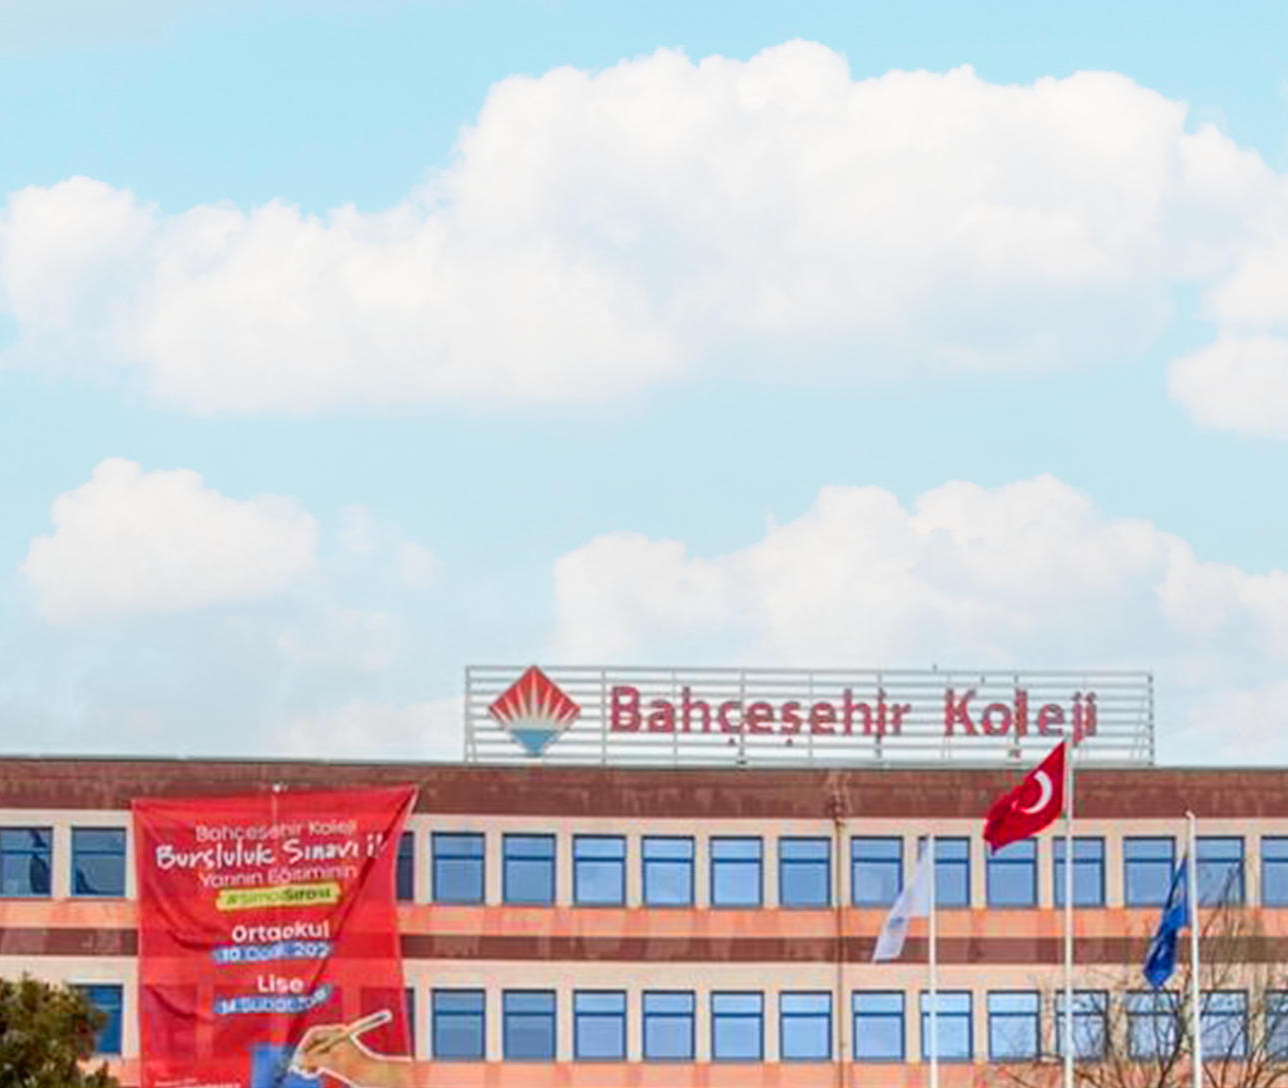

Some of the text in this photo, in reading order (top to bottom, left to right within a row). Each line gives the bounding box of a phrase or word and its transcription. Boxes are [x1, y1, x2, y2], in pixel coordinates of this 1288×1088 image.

[610, 685, 1098, 747] Bahçeşehir Koleji
[232, 920, 330, 942] Ortaokul
[258, 974, 304, 993] Lise
